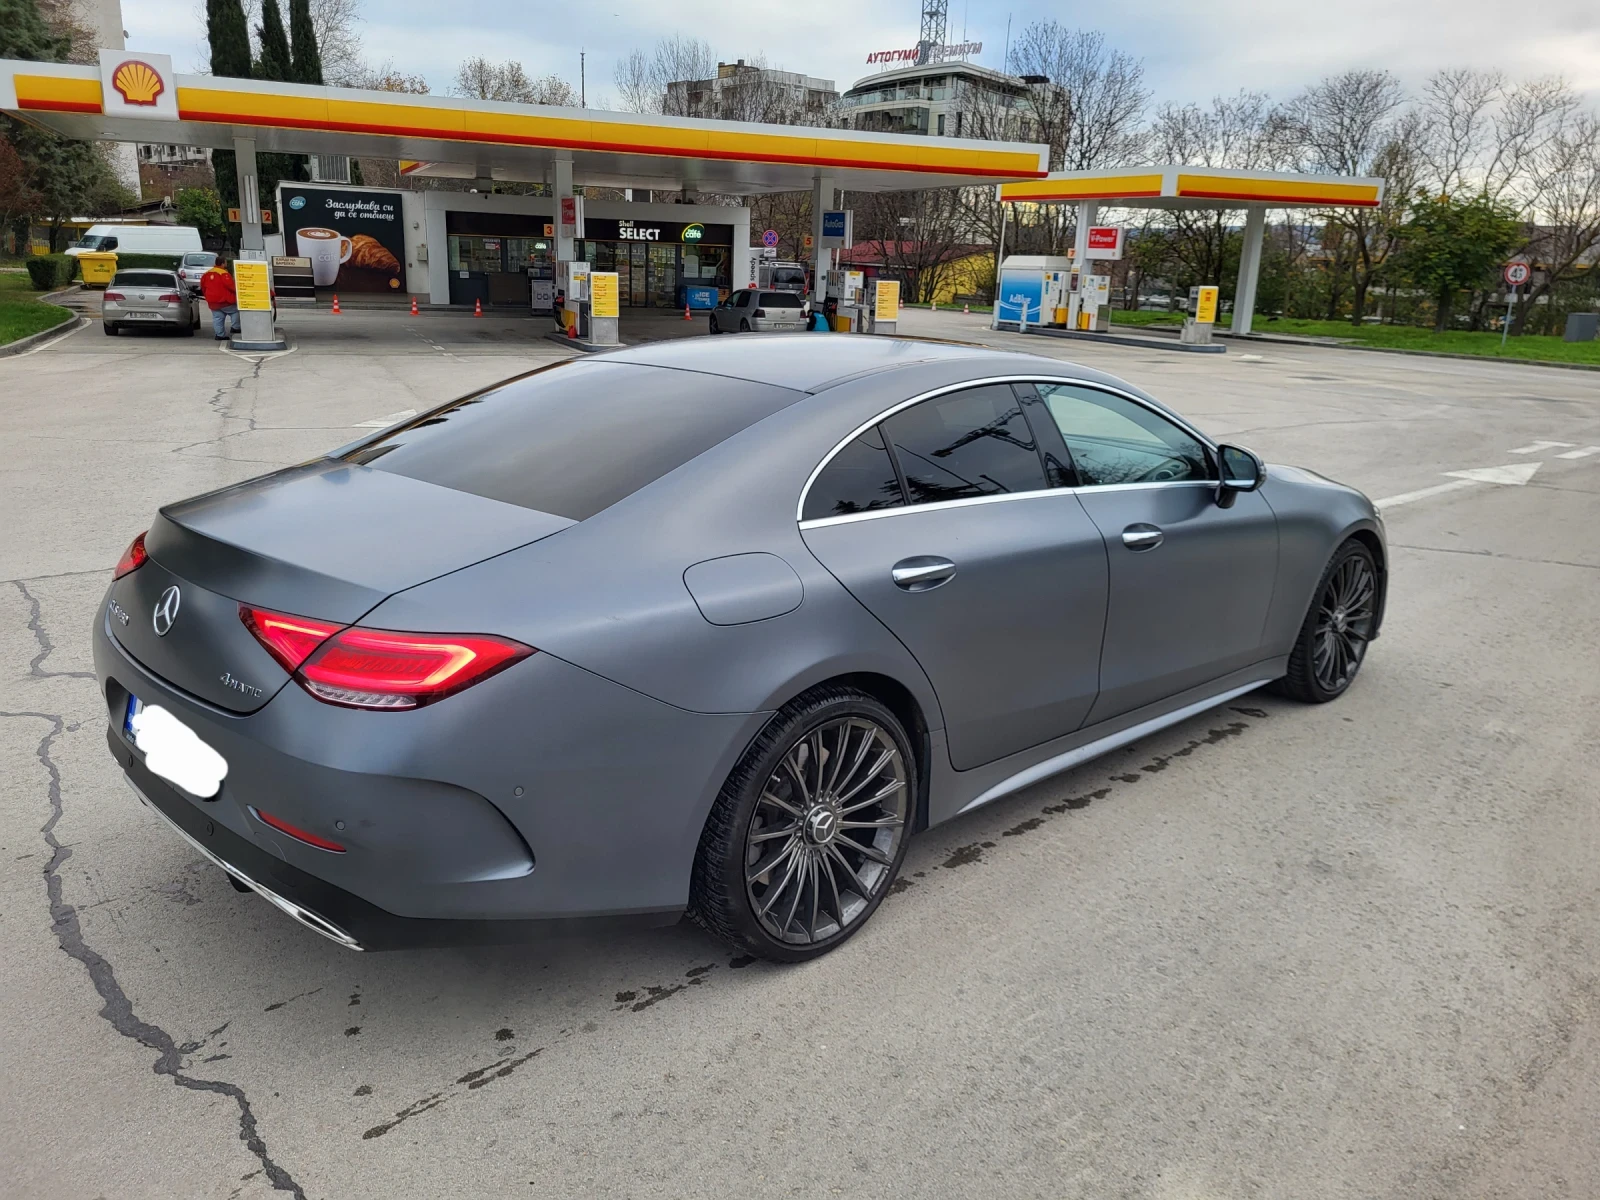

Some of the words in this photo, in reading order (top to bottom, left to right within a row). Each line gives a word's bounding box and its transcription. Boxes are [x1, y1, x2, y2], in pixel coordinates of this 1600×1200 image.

[866, 48, 919, 64] АУТОГУМИ
[325, 199, 380, 212] Заслужава
[232, 211, 237, 220] 1
[265, 212, 270, 221] 2
[334, 210, 345, 219] да
[825, 219, 843, 228] AutoGas
[546, 226, 552, 235] 3
[619, 228, 660, 240] SELECT
[805, 237, 812, 245] 5
[749, 257, 757, 281] speedy
[220, 672, 262, 698] 4MATIC
